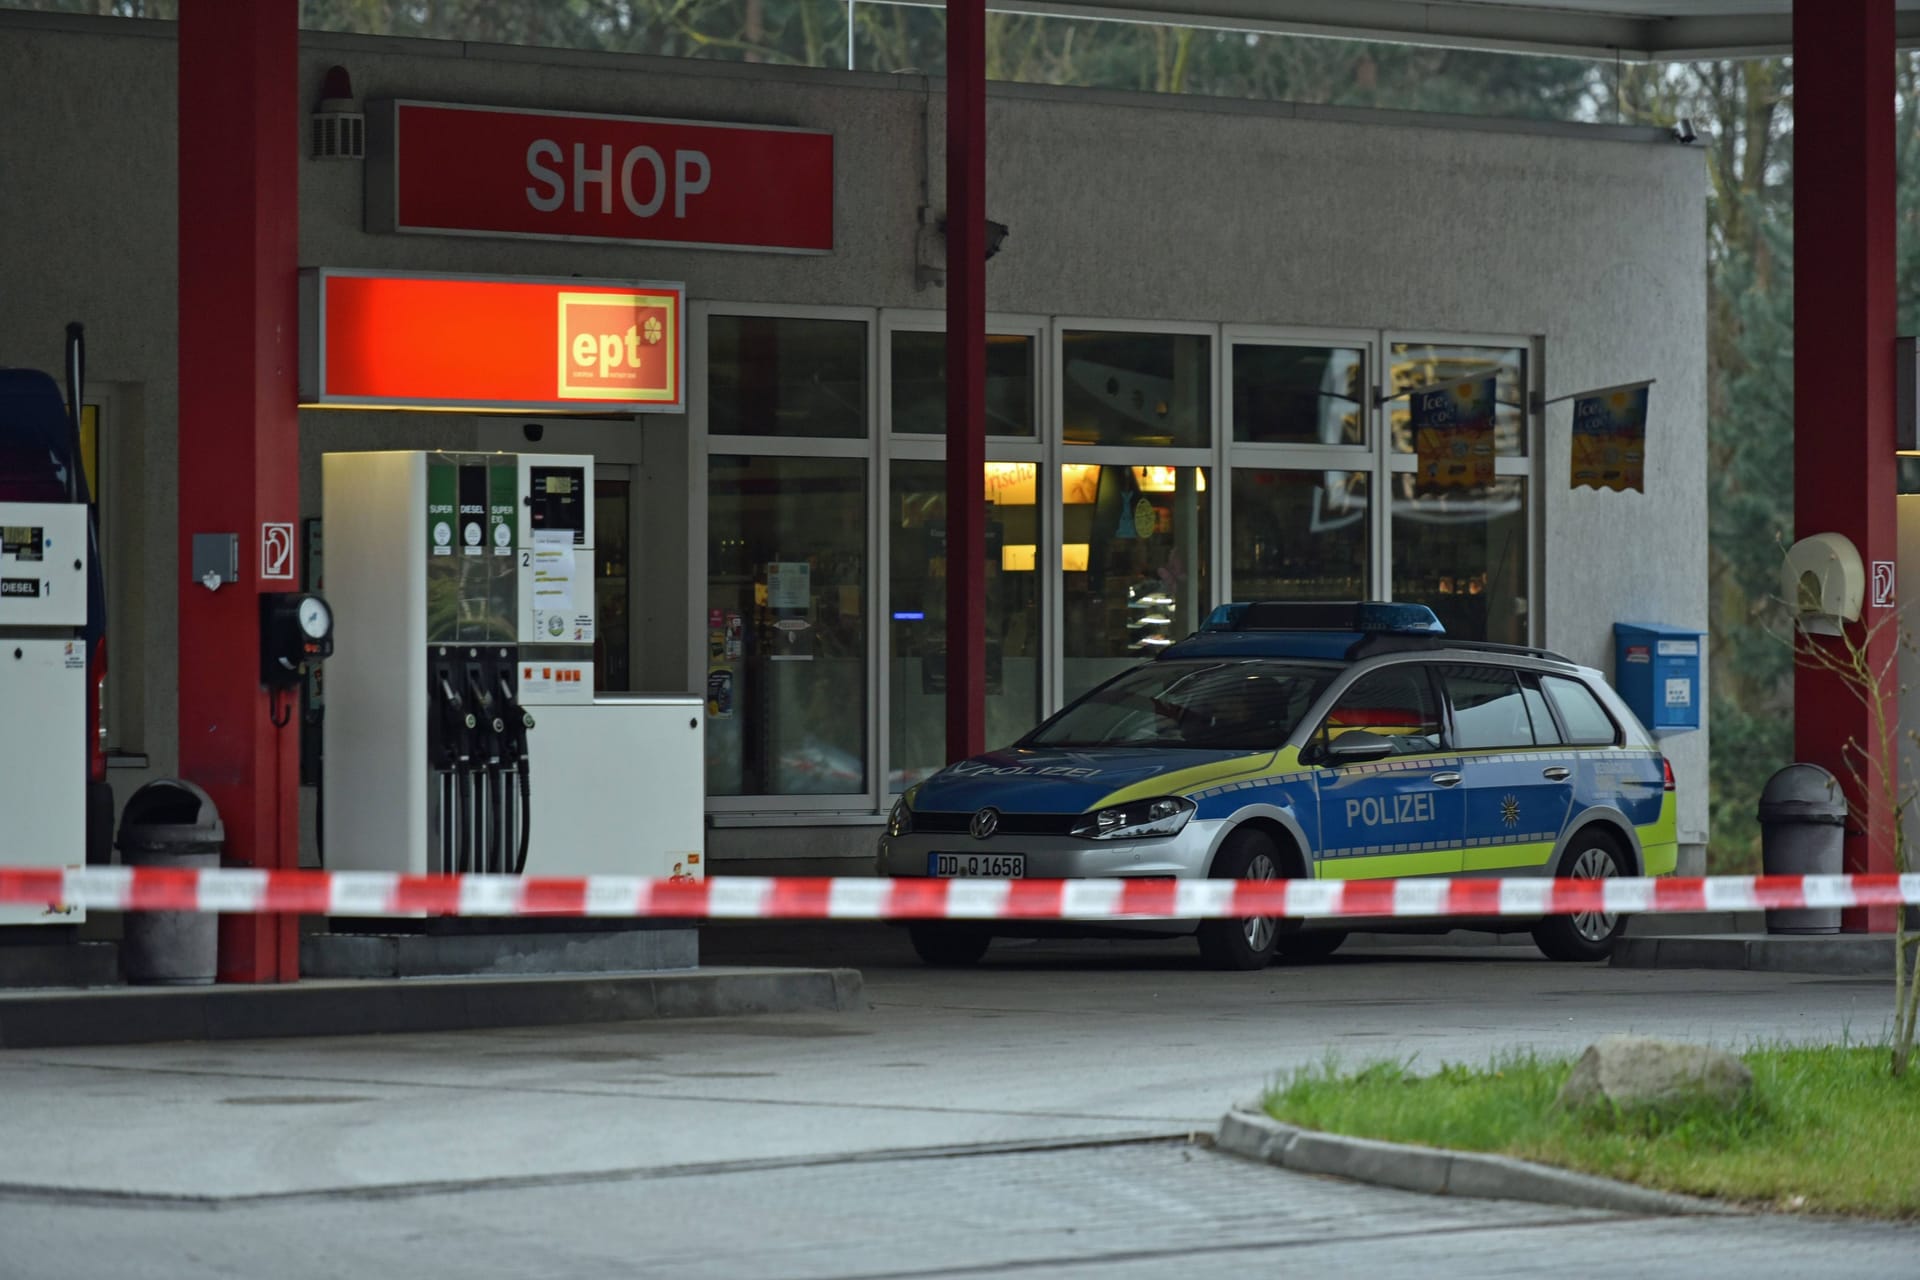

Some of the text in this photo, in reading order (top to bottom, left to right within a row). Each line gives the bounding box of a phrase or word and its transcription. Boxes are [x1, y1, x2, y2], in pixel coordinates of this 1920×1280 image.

[526, 138, 712, 219] SHOP
[572, 325, 641, 378] ept
[429, 504, 453, 514] SUPER
[460, 504, 484, 514] DIESEL
[491, 505, 514, 514] SUPER
[491, 515, 504, 524] E10
[522, 552, 530, 568] 2
[2, 582, 35, 593] DIESEL
[44, 581, 50, 597] 1
[970, 765, 1104, 778] POLIZEI
[1345, 792, 1436, 828] POLIZEI
[938, 855, 1023, 877] DD Q 1658
